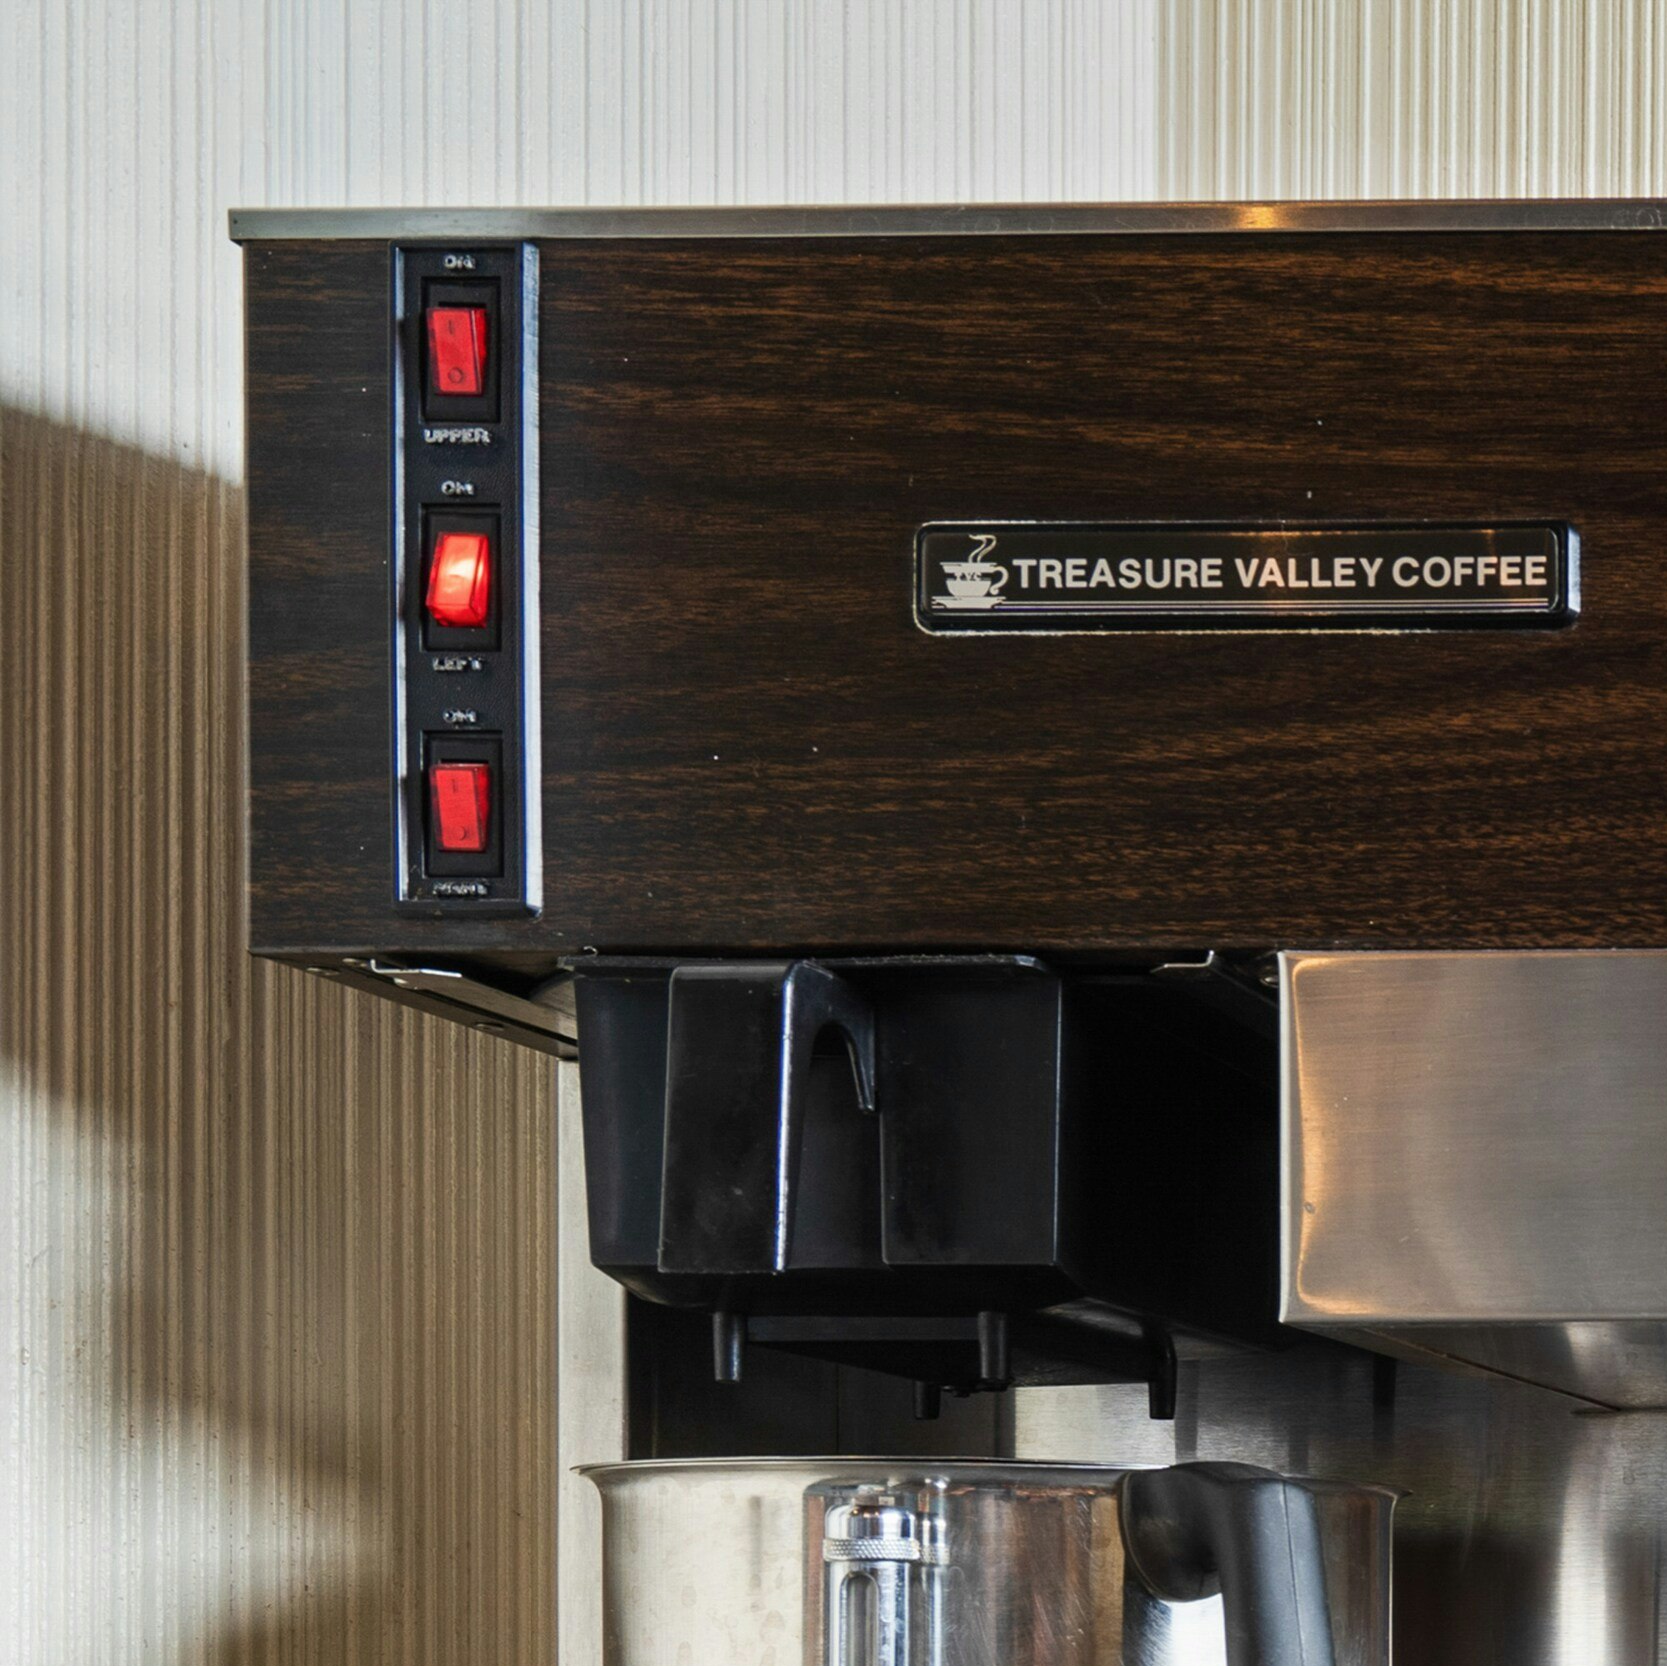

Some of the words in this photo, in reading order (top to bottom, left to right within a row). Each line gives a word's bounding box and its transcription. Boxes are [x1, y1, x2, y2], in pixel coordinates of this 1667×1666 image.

[423, 427, 492, 445] UPPER
[1012, 556, 1224, 590] TREASURE
[1234, 555, 1384, 589] VALLEY
[1391, 554, 1549, 588] COFFEE
